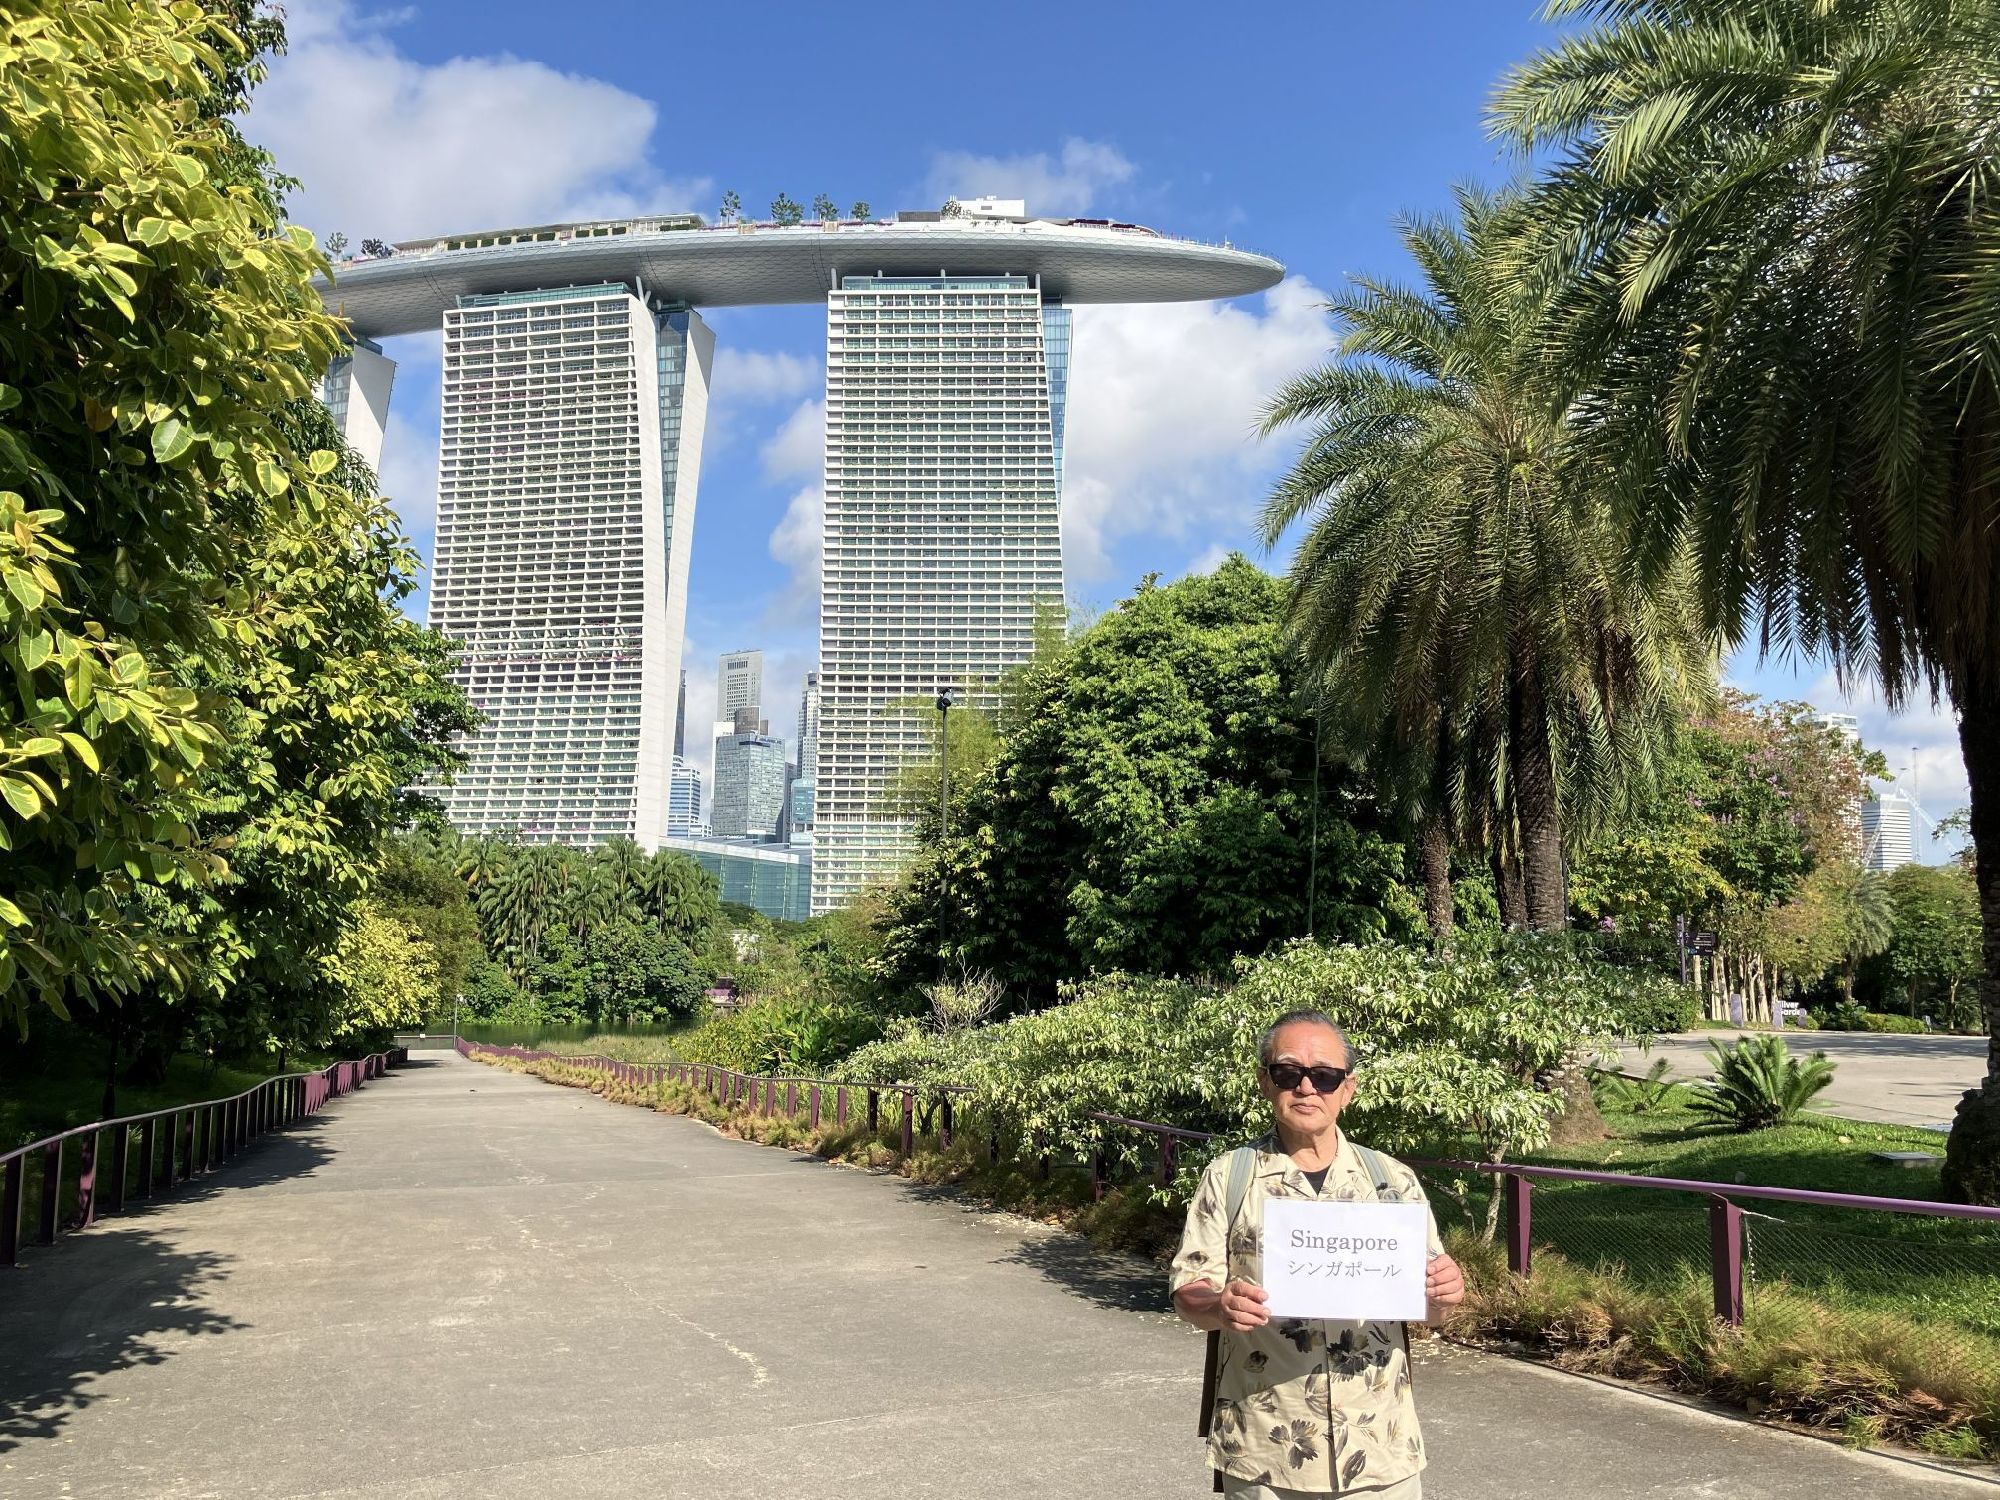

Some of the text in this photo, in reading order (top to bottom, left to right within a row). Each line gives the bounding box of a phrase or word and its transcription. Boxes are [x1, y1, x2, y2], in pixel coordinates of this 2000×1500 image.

[1780, 1008, 1807, 1016] arde
[1291, 1229, 1398, 1254] Singapore
[1288, 1259, 1402, 1278] シンガポール
